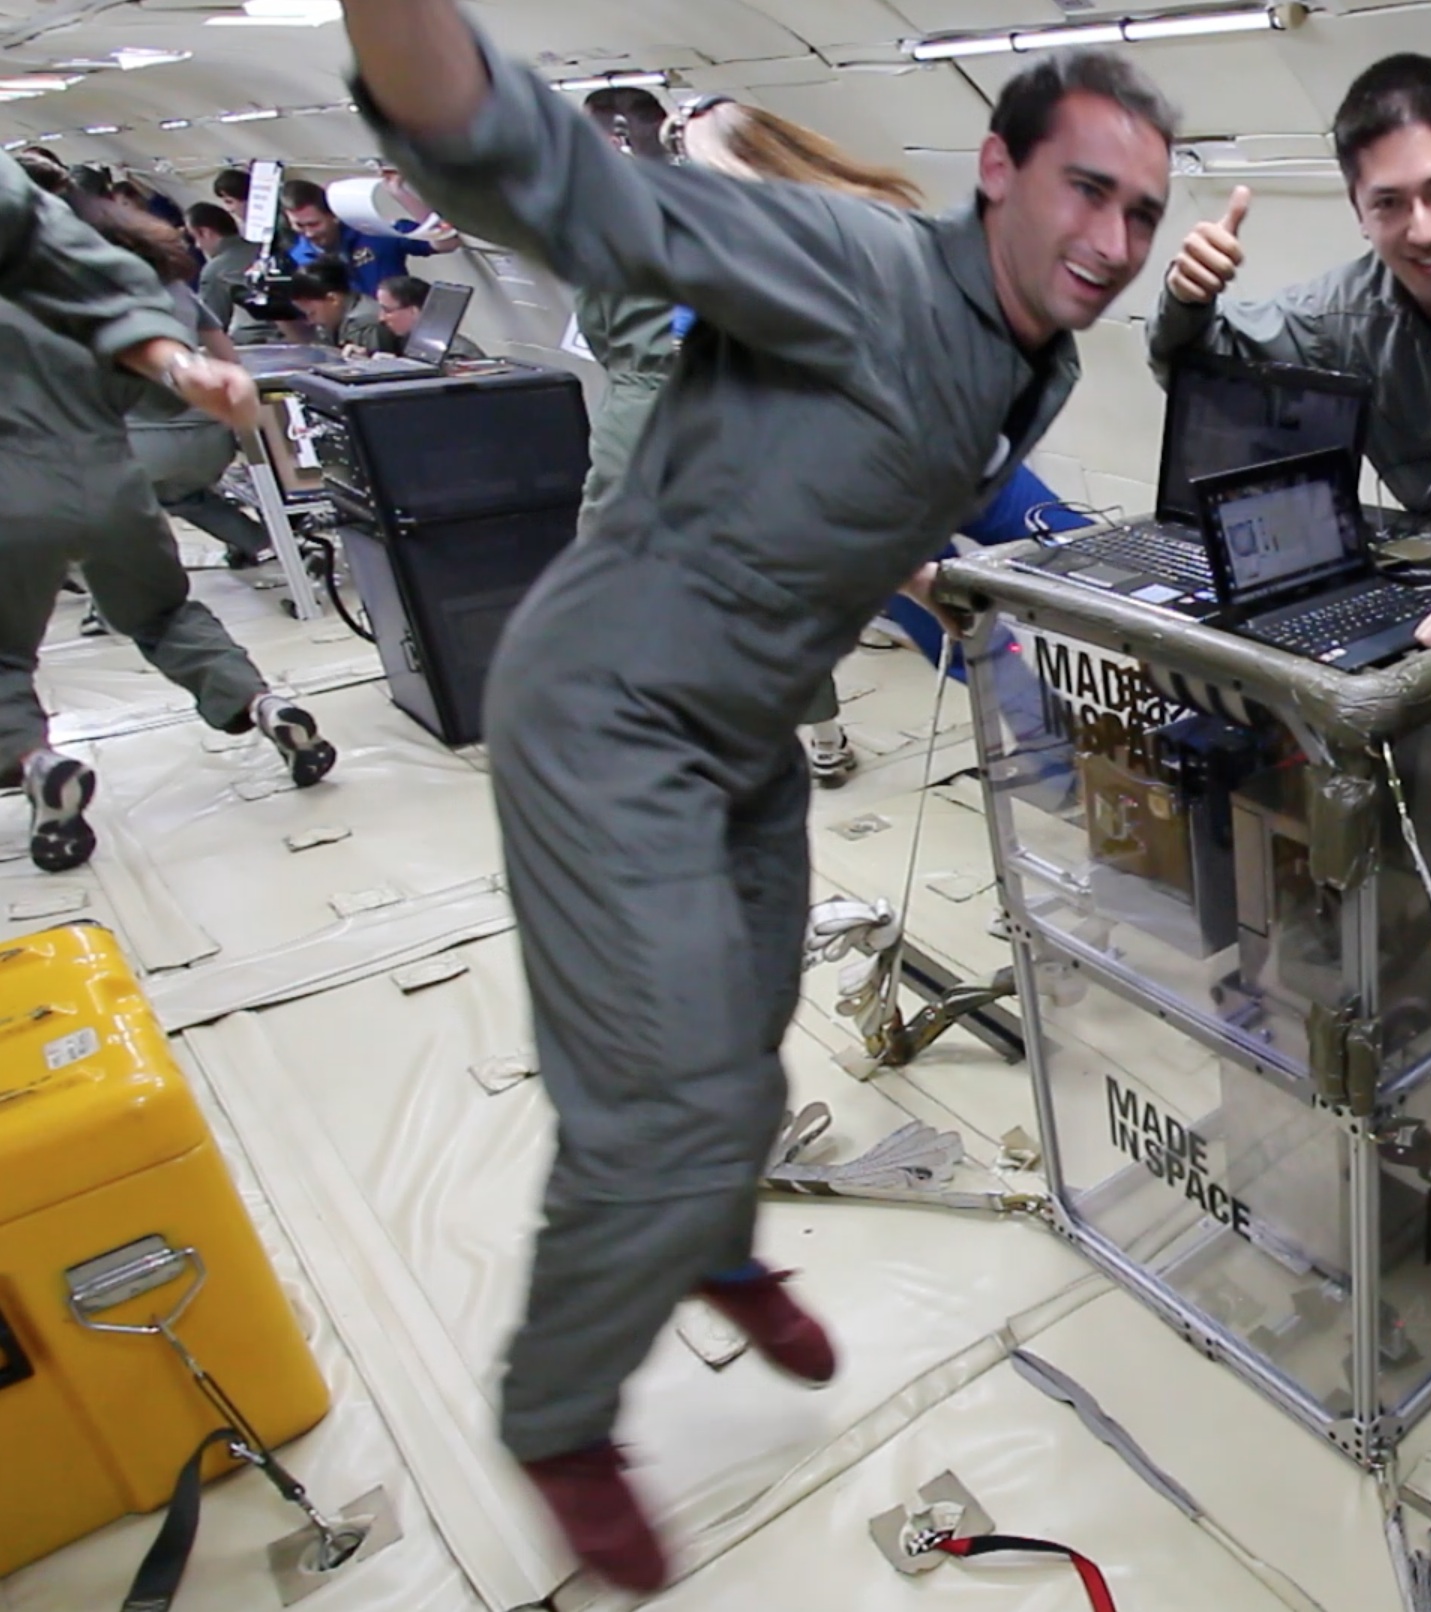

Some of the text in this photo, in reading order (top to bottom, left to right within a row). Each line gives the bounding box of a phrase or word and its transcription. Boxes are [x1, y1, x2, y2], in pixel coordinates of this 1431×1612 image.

[1106, 1074, 1209, 1176] MADE
[1109, 1118, 1252, 1243] IN SPACE
